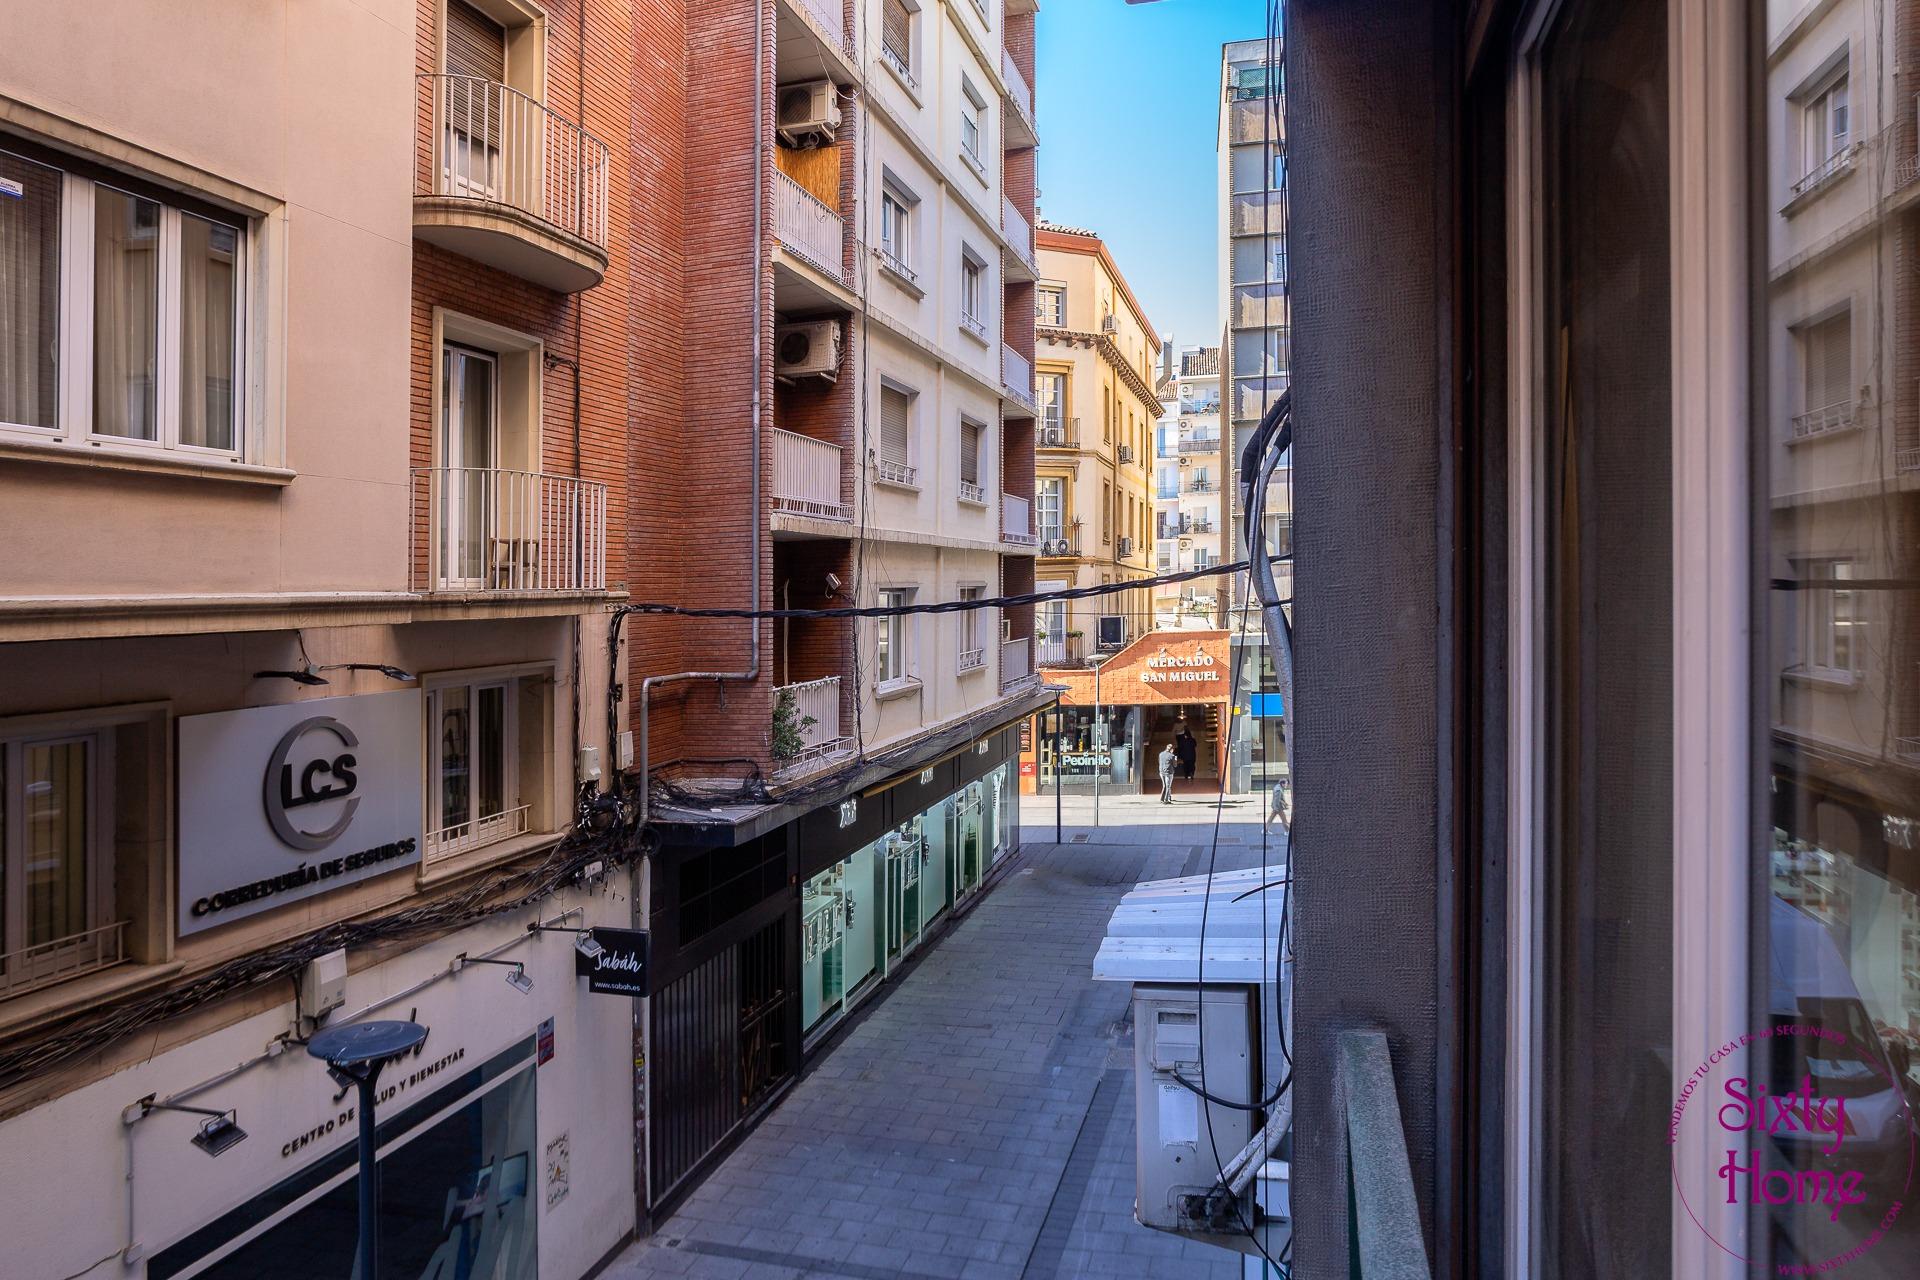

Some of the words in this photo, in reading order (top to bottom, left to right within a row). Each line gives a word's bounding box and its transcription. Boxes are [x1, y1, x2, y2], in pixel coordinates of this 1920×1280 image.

[1148, 655, 1214, 668] MERCADO
[1141, 672, 1167, 683] SAN
[1169, 670, 1220, 682] MIGUEL
[1062, 755, 1112, 766] Pepinllo
[281, 754, 357, 809] LCS
[191, 862, 319, 917] CORREDURÍA
[320, 857, 343, 880] DE
[345, 837, 416, 871] SEGUROS
[594, 981, 641, 992] www.sabah.es
[281, 1119, 335, 1157] CENTRO
[338, 1107, 356, 1127] DE
[399, 1079, 406, 1089] Y
[409, 1047, 465, 1088] BIENESTAR
